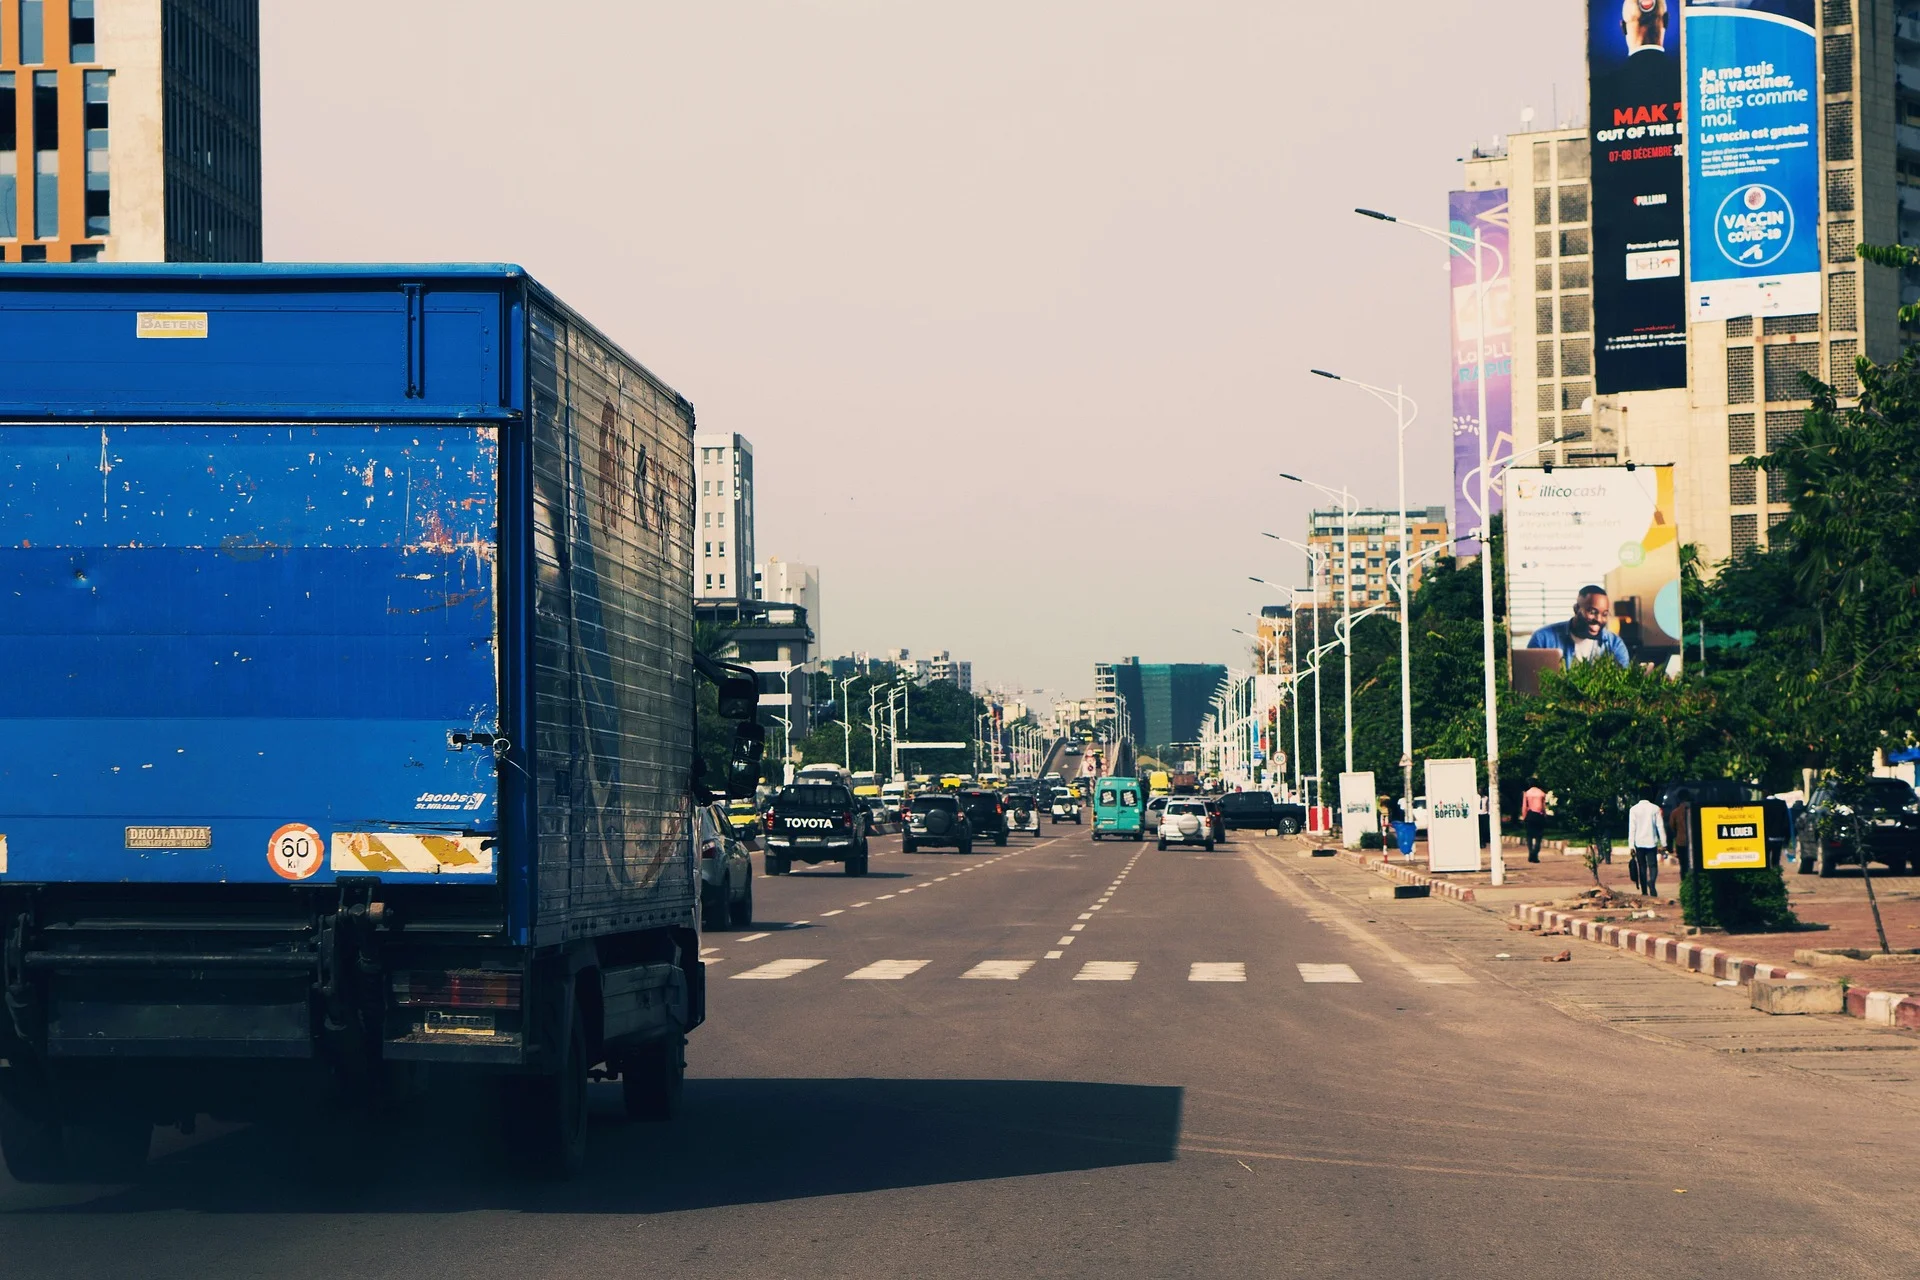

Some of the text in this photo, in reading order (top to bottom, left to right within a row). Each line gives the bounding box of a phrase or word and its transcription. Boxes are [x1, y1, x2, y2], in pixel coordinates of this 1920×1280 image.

[1700, 61, 1774, 81] Je me suis
[1700, 78, 1726, 95] fait
[1701, 88, 1808, 111] faites comme
[1614, 104, 1668, 126] MAK
[1701, 109, 1737, 128] moi.
[1597, 128, 1625, 142] OUT
[1626, 125, 1646, 139] OF
[1647, 123, 1674, 137] THE
[1701, 123, 1809, 145] Le vaccin est gratuit
[1633, 145, 1673, 160] DÉCEMBRE
[1723, 210, 1784, 230] VACCIN
[1728, 228, 1782, 243] COVID-19
[416, 792, 468, 803] Jacobs
[784, 817, 834, 829] TOYOTA
[1435, 809, 1461, 819] BOPETO
[130, 828, 206, 840] DHOLLANDIA
[1730, 826, 1753, 836] LOUER
[282, 837, 309, 858] 60
